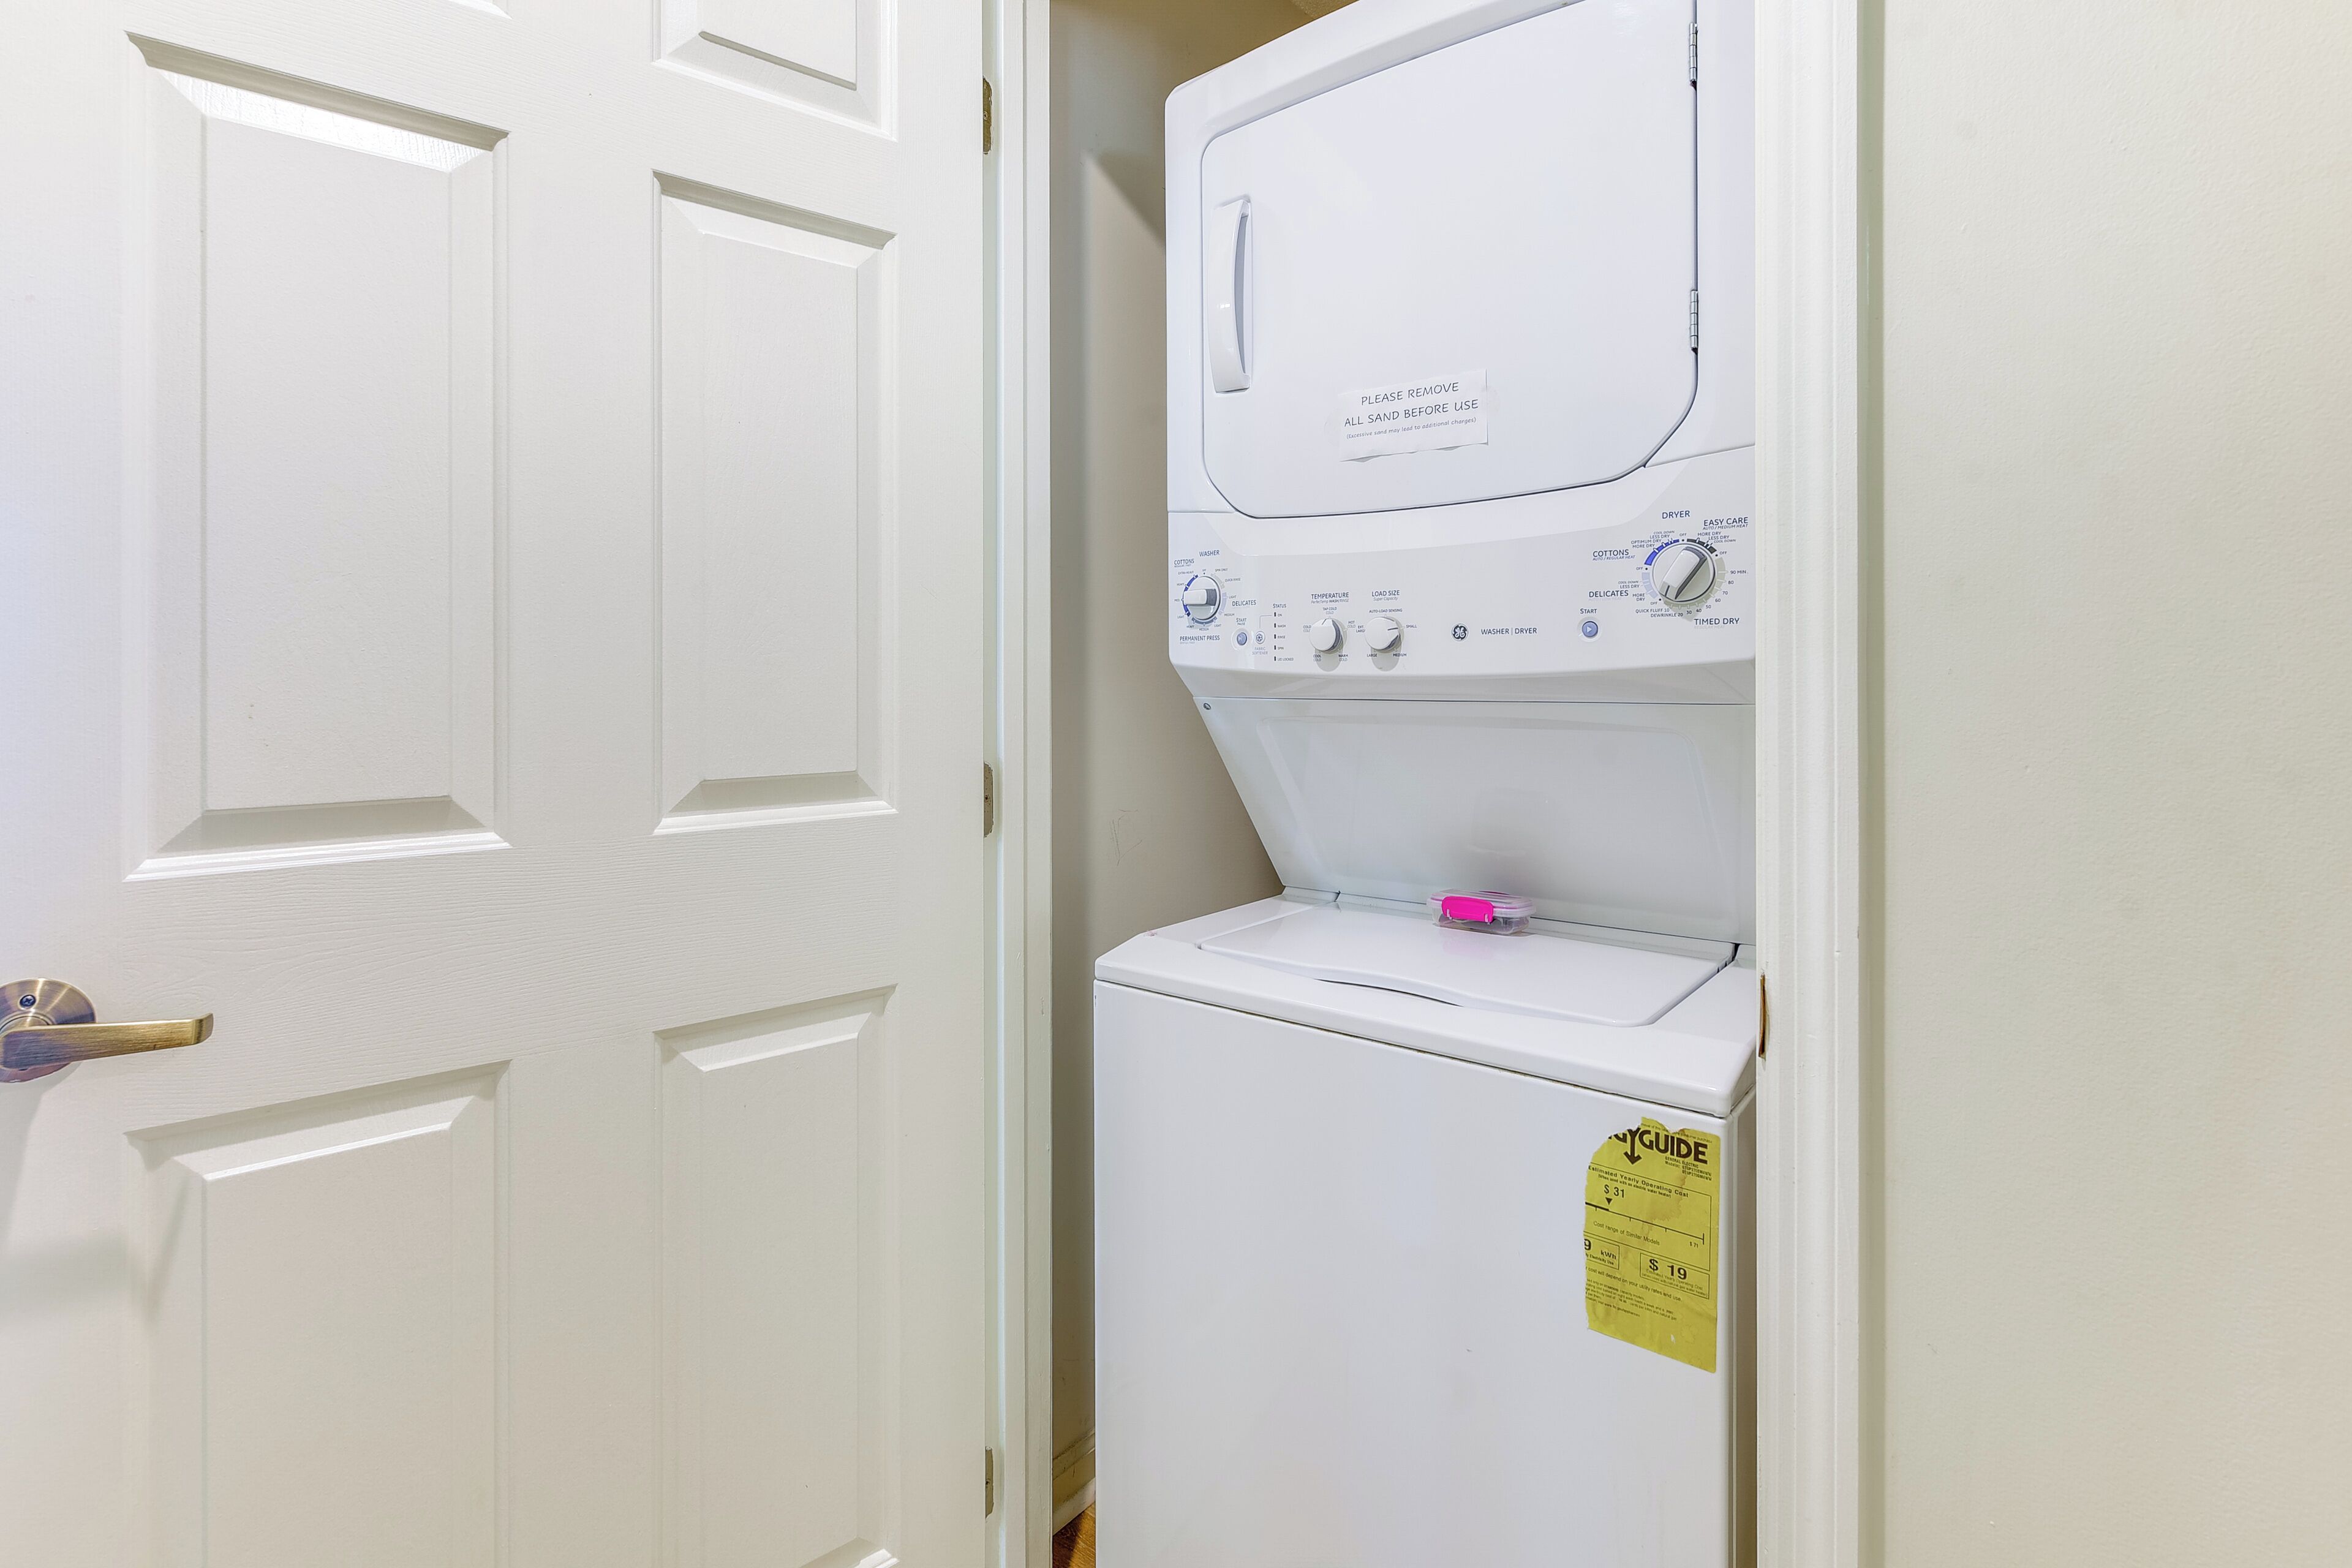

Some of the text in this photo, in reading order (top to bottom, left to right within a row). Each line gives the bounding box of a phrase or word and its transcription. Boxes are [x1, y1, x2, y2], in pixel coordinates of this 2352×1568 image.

[1362, 382, 1459, 405] PLEASE REMOVE
[1344, 399, 1479, 427] ALL SAND BEFORE USE
[1346, 431, 1373, 440] (Excessive
[1422, 420, 1449, 429] additional
[1451, 417, 1476, 426] charges)
[1662, 510, 1690, 519] DRYER
[1682, 1160, 1698, 1169] ELECTRIC
[1588, 1165, 1618, 1178] Estimated
[1619, 1174, 1639, 1184] Yearly
[1642, 1180, 1672, 1194] Operating
[1604, 1184, 1624, 1198] $ 31
[1605, 1224, 1619, 1233] range
[1626, 1231, 1642, 1240] Similar
[1643, 1236, 1660, 1246] Models
[1600, 1250, 1616, 1260] kWh
[1649, 1258, 1687, 1280] $ 19
[1605, 1272, 1621, 1282] depend
[1639, 1283, 1650, 1292] utility
